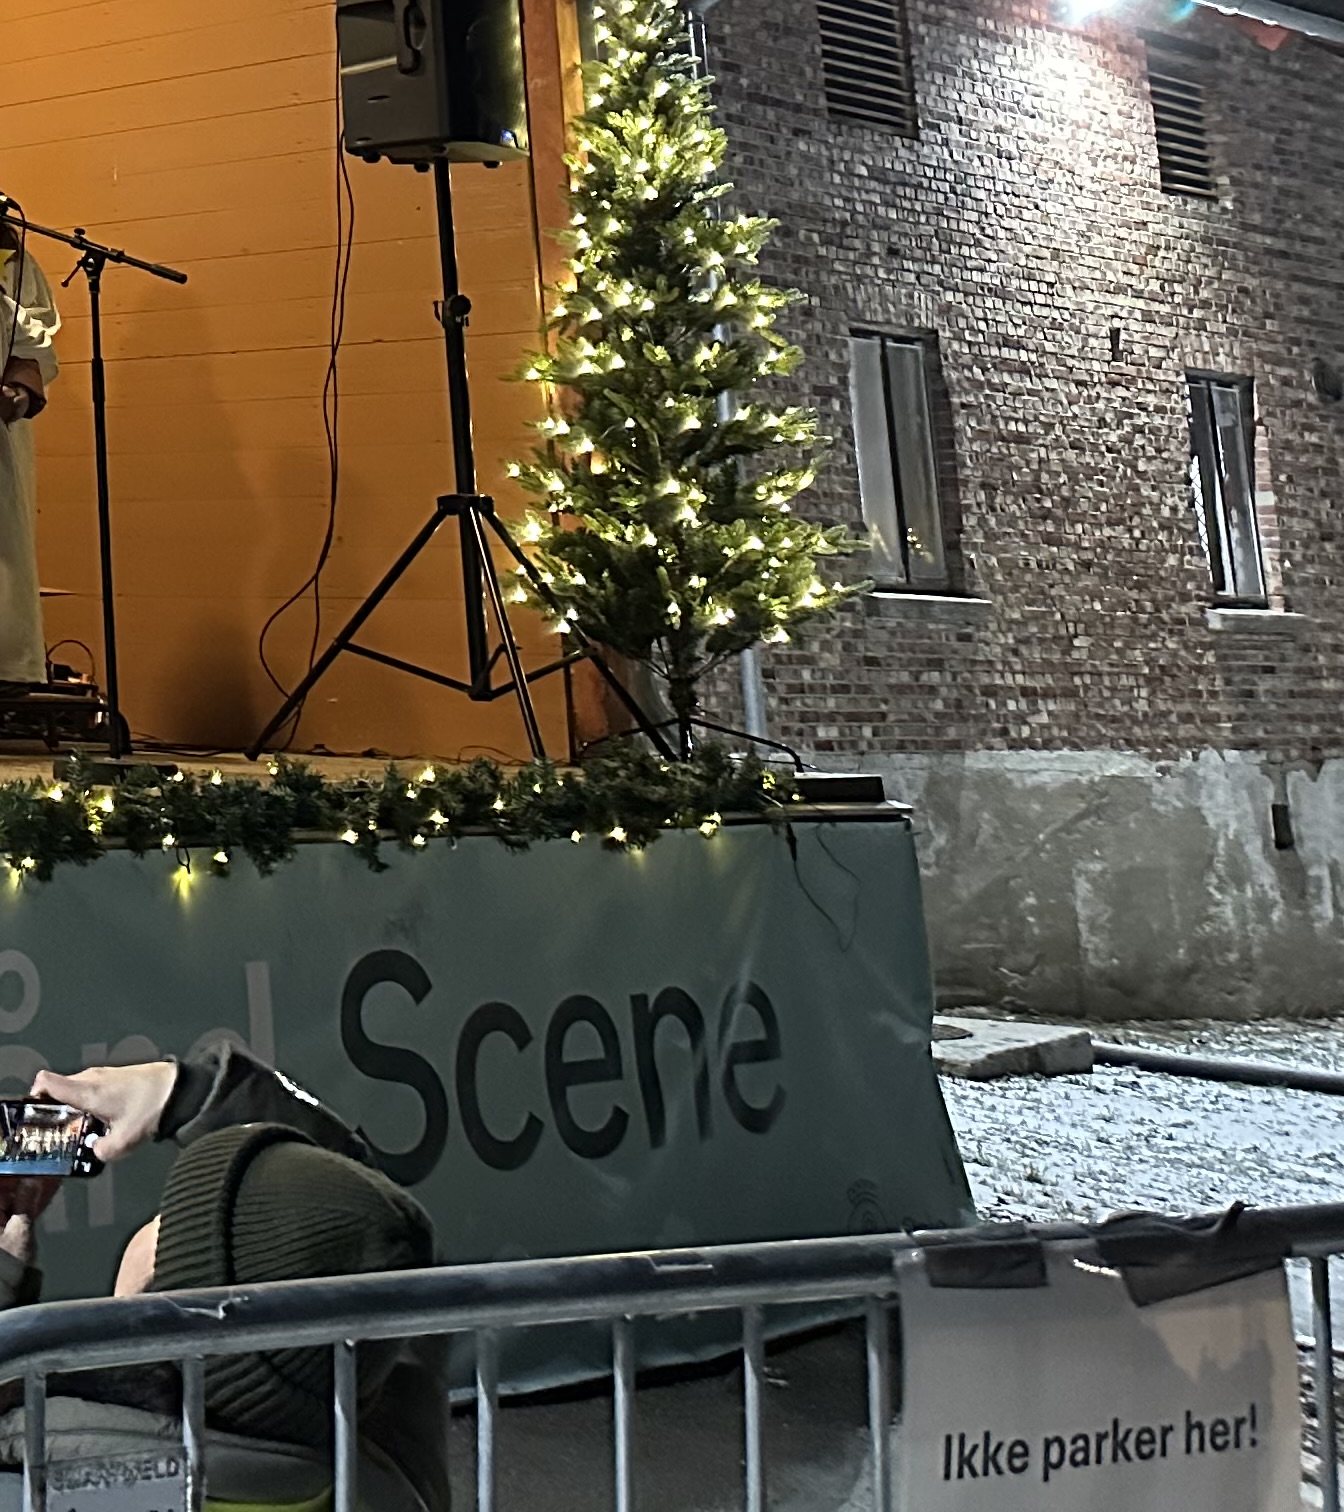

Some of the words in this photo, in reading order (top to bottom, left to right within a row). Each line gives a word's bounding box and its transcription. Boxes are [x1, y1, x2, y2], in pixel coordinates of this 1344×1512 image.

[340, 949, 786, 1186] Scene
[943, 1431, 1030, 1481] Ikke
[1042, 1418, 1174, 1482] parker
[1185, 1403, 1257, 1455] her!
